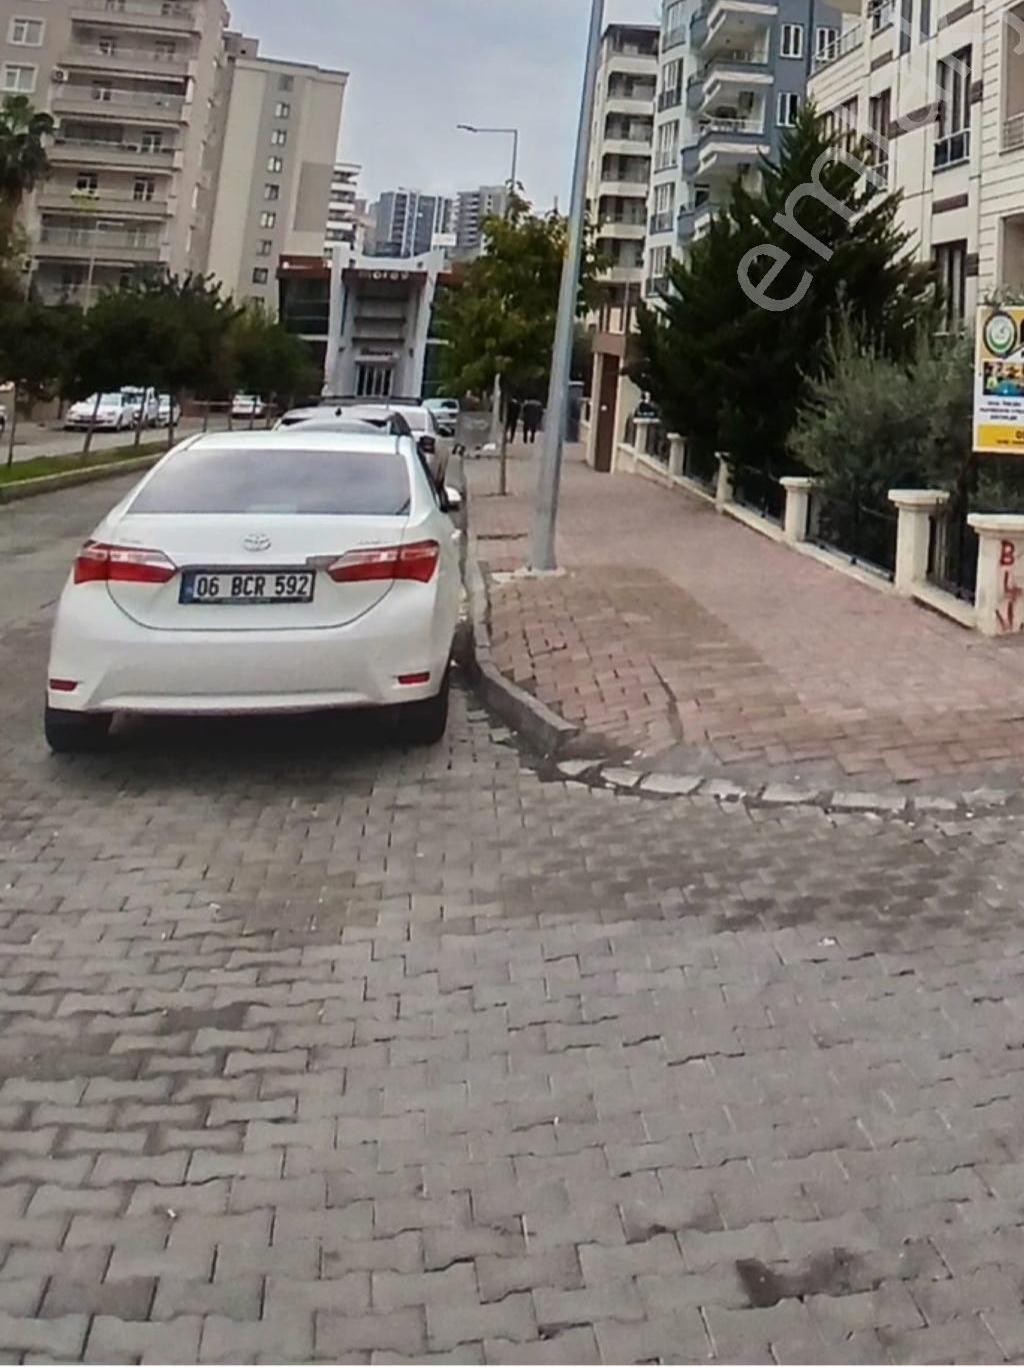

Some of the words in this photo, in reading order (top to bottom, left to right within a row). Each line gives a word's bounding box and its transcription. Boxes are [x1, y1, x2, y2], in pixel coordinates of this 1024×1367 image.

[197, 576, 220, 596] 06
[231, 575, 266, 596] BCR
[275, 575, 310, 595] 592
